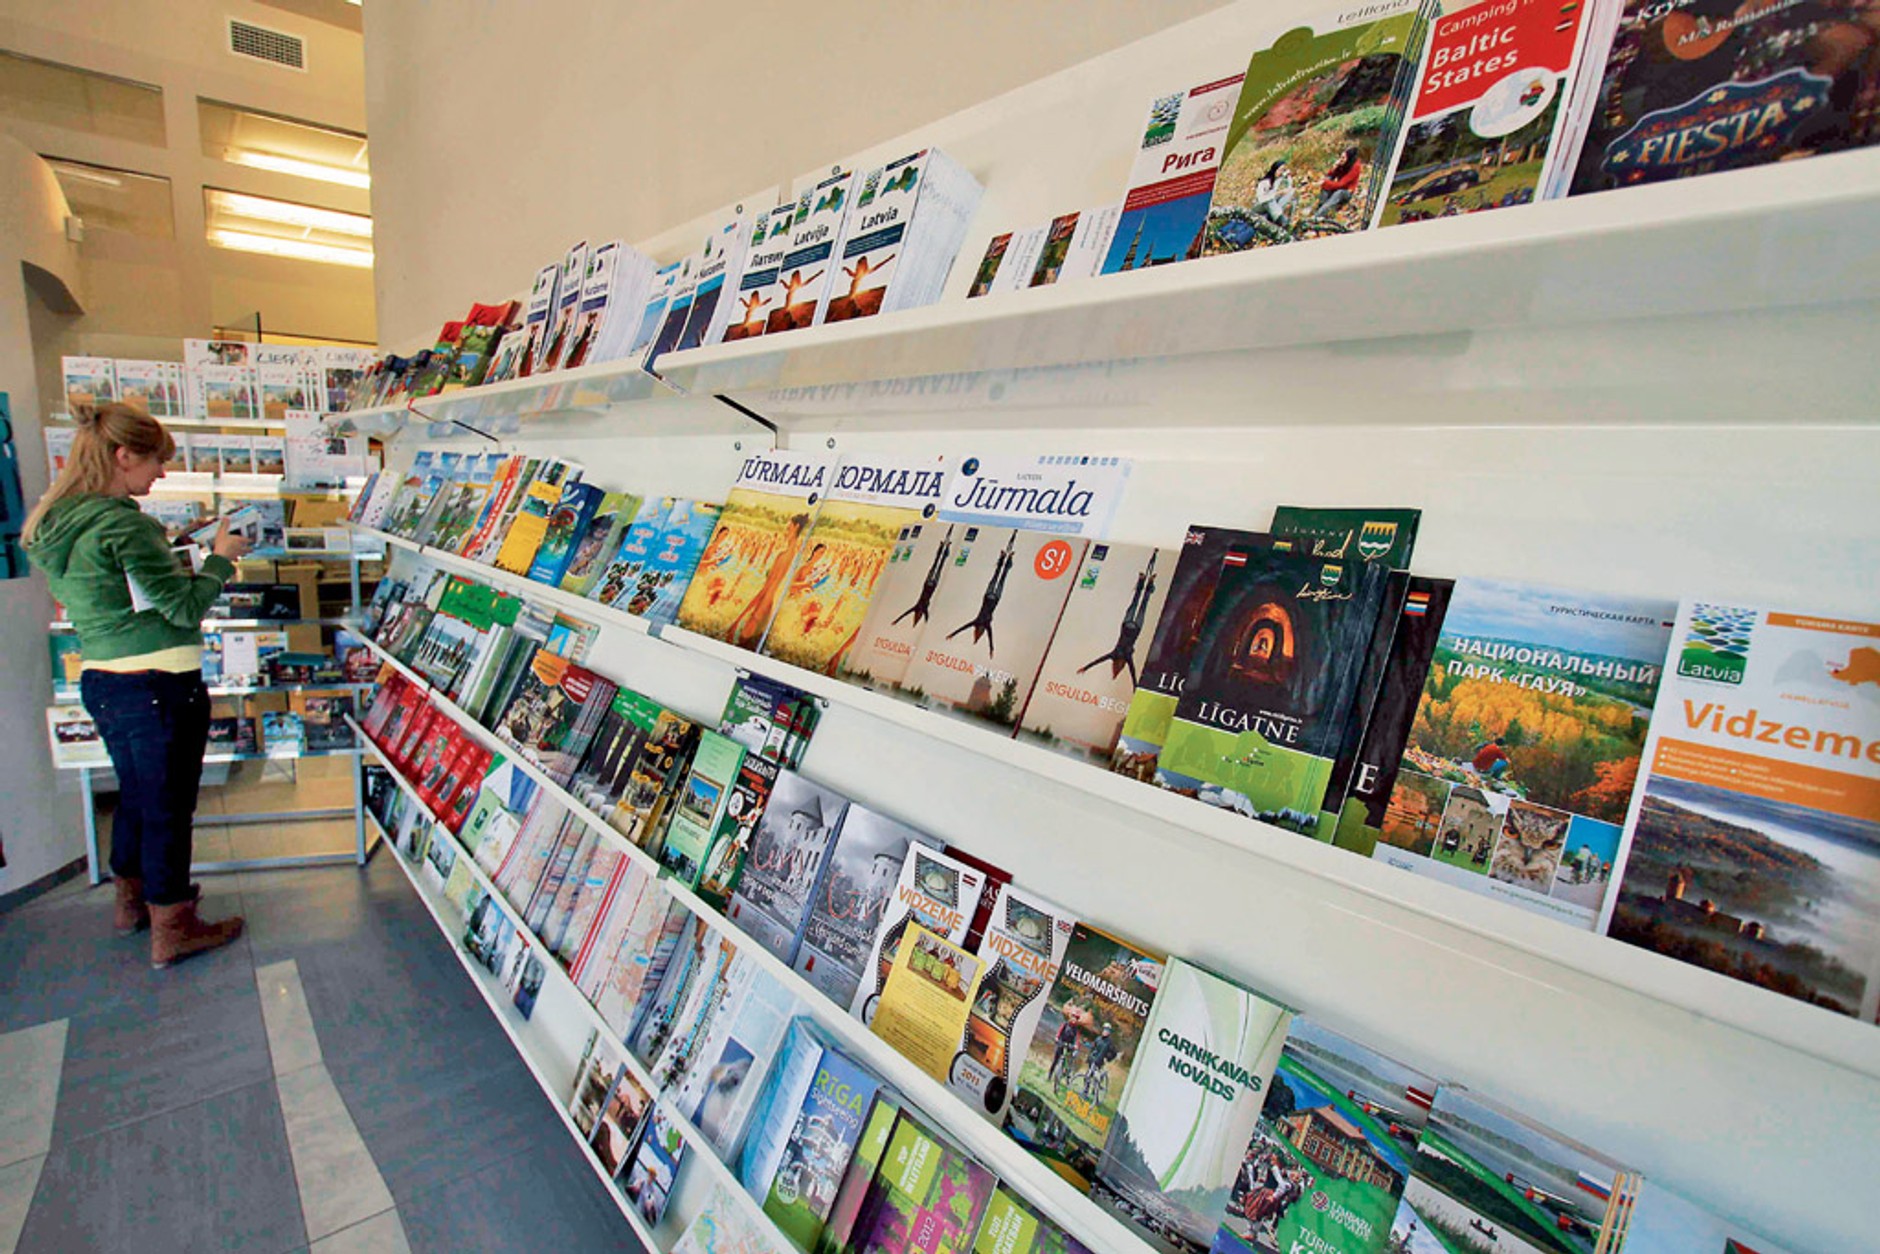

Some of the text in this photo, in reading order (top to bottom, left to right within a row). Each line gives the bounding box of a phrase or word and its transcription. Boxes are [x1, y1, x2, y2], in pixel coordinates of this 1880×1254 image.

[1439, 1, 1517, 37] Camping
[1432, 26, 1516, 70] Baltic
[1425, 50, 1519, 95] States
[1636, 101, 1788, 165] FIESTA
[1161, 147, 1216, 174] Рига
[794, 224, 829, 247] Latvija
[860, 206, 899, 230] Latvia
[737, 456, 825, 487] JŪRMALA
[835, 466, 944, 497] ЮРМАЛА
[954, 477, 1094, 516] Jūrmala
[1040, 548, 1066, 572] S!
[1550, 605, 1656, 626] ТУРИСТИЧЕСКАЯ КАРТА
[1447, 660, 1586, 698] ПАРК «ГАУЯ»
[1453, 637, 1658, 685] НАЦИОНАЛЬНЫЙ
[1679, 658, 1743, 684] Latvia
[1198, 701, 1301, 744] LĪGATNE
[898, 884, 965, 933] VIDZEME
[987, 930, 1060, 984] VIDZEME
[1158, 1027, 1264, 1093] CARNIKAVAS
[1167, 1054, 1236, 1103] NOVADS
